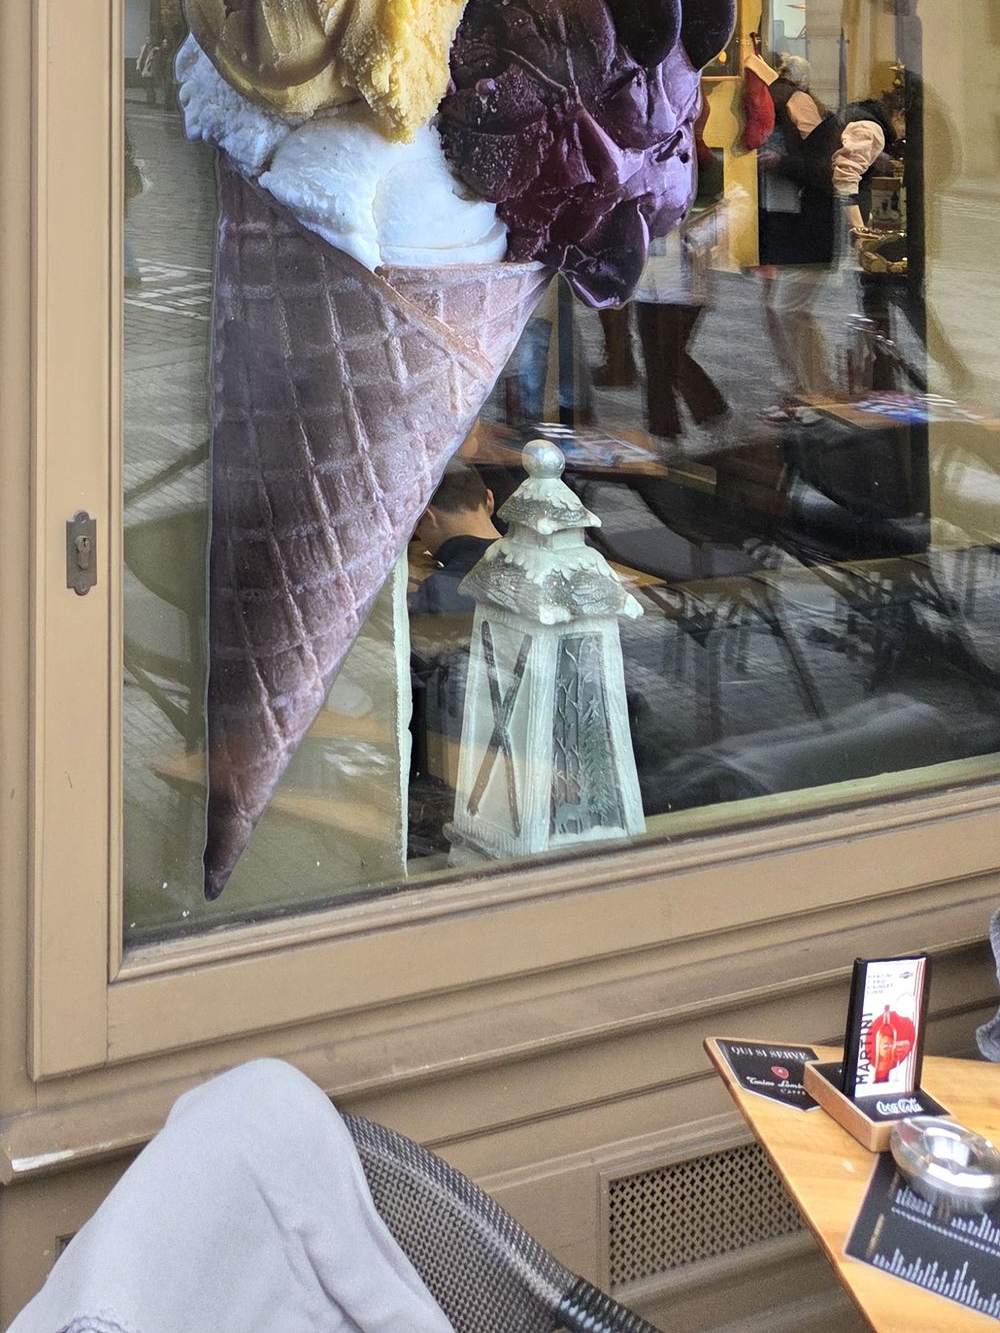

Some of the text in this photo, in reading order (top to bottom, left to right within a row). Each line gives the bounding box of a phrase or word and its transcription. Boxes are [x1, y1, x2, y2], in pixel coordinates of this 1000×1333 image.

[731, 1046, 809, 1060] QUI SI SERVE
[856, 1013, 873, 1084] MARTINI
